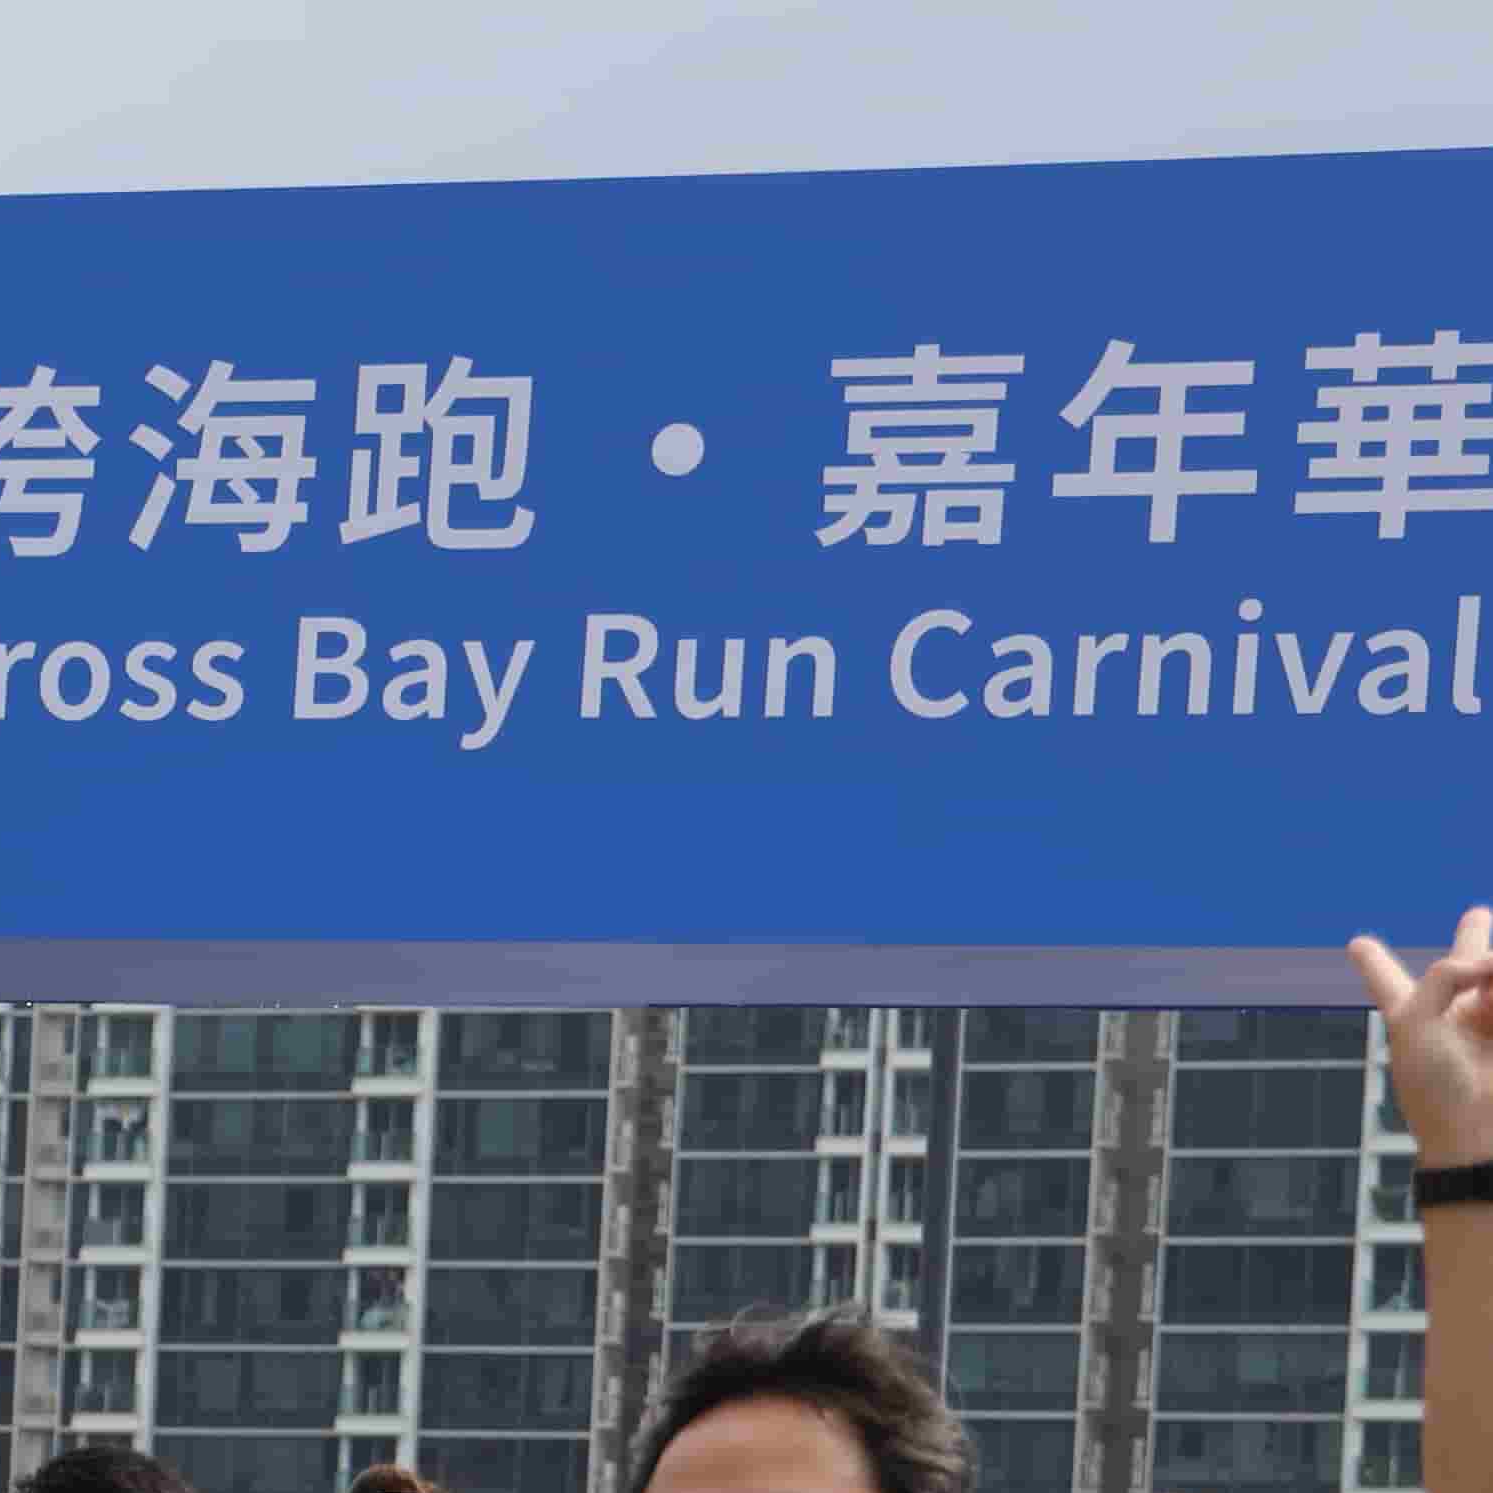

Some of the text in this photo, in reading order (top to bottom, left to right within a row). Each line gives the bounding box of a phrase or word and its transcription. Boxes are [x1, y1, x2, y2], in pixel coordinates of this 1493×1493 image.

[292, 613, 535, 750] Bay
[578, 613, 837, 721] Run
[888, 594, 1484, 720] Carnival
